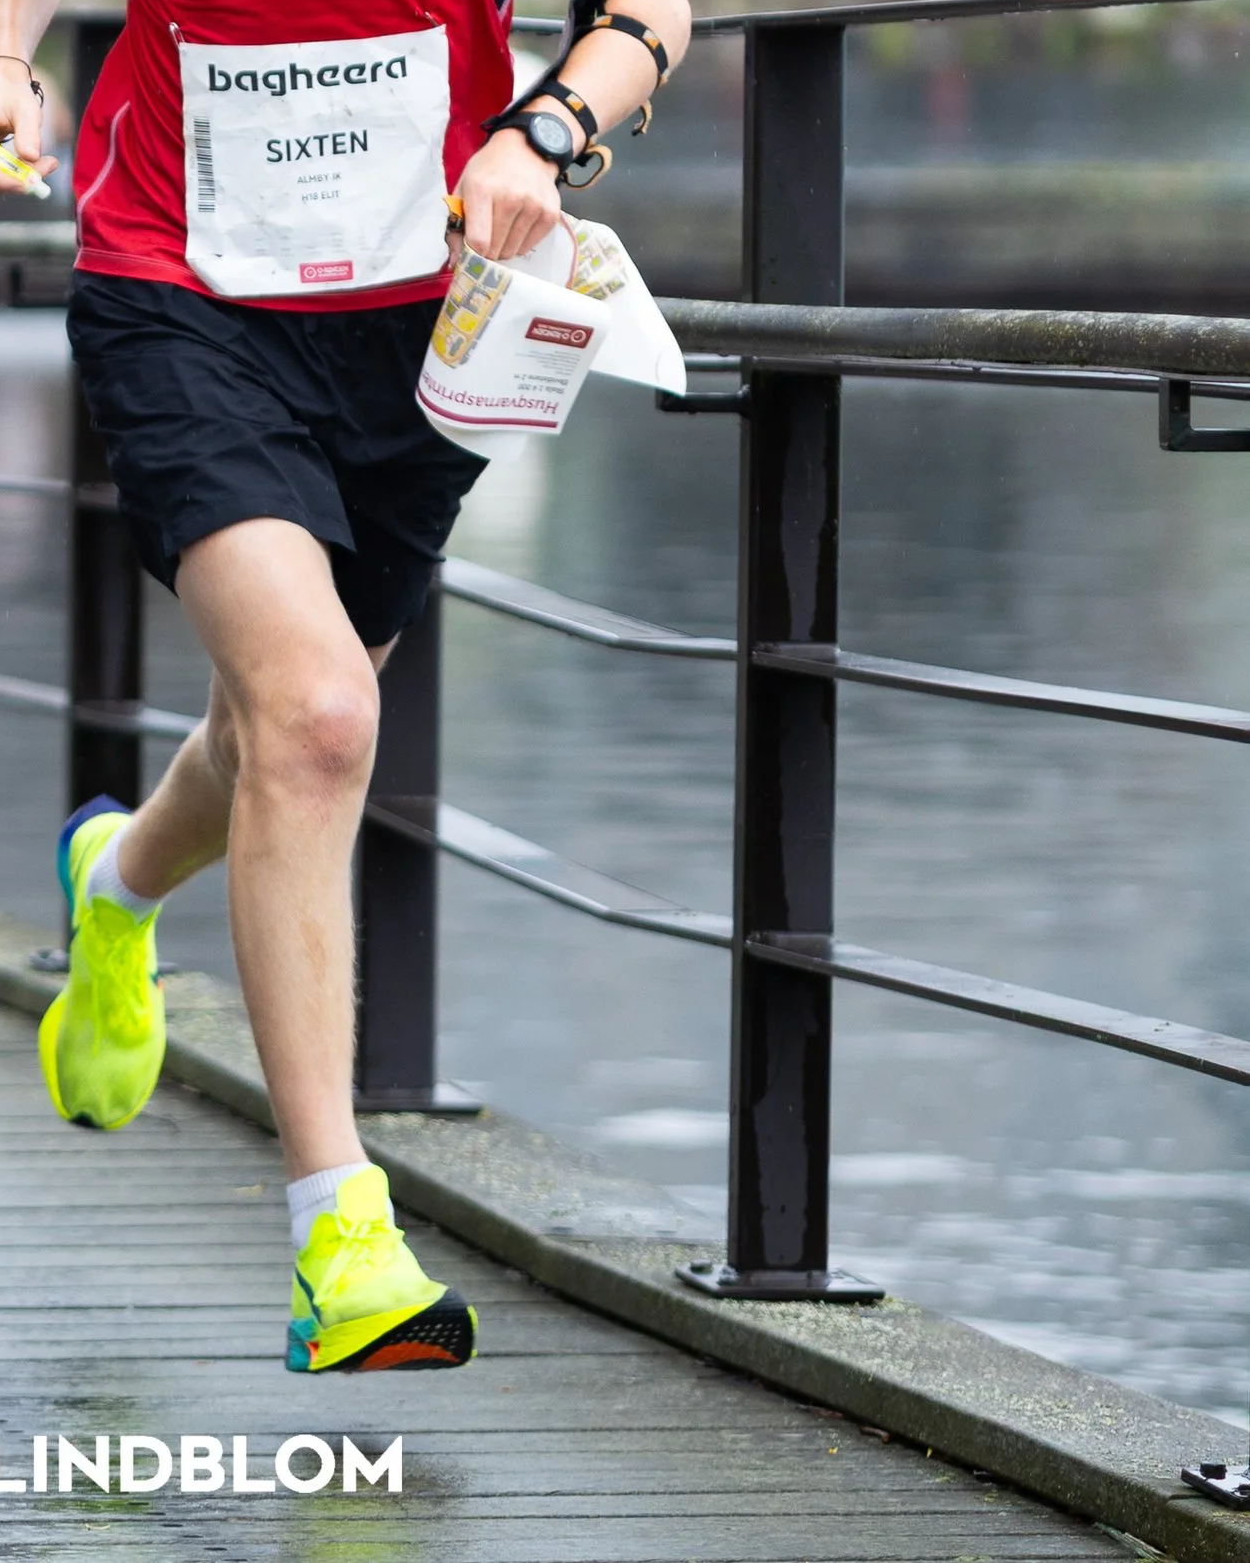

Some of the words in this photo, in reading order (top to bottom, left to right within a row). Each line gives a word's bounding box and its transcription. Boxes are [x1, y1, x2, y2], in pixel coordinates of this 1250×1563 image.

[208, 55, 408, 96] bagheera
[266, 130, 368, 162] SIXTEN
[297, 173, 330, 184] ALMBY
[332, 171, 342, 180] IK
[321, 190, 340, 200] ELIT
